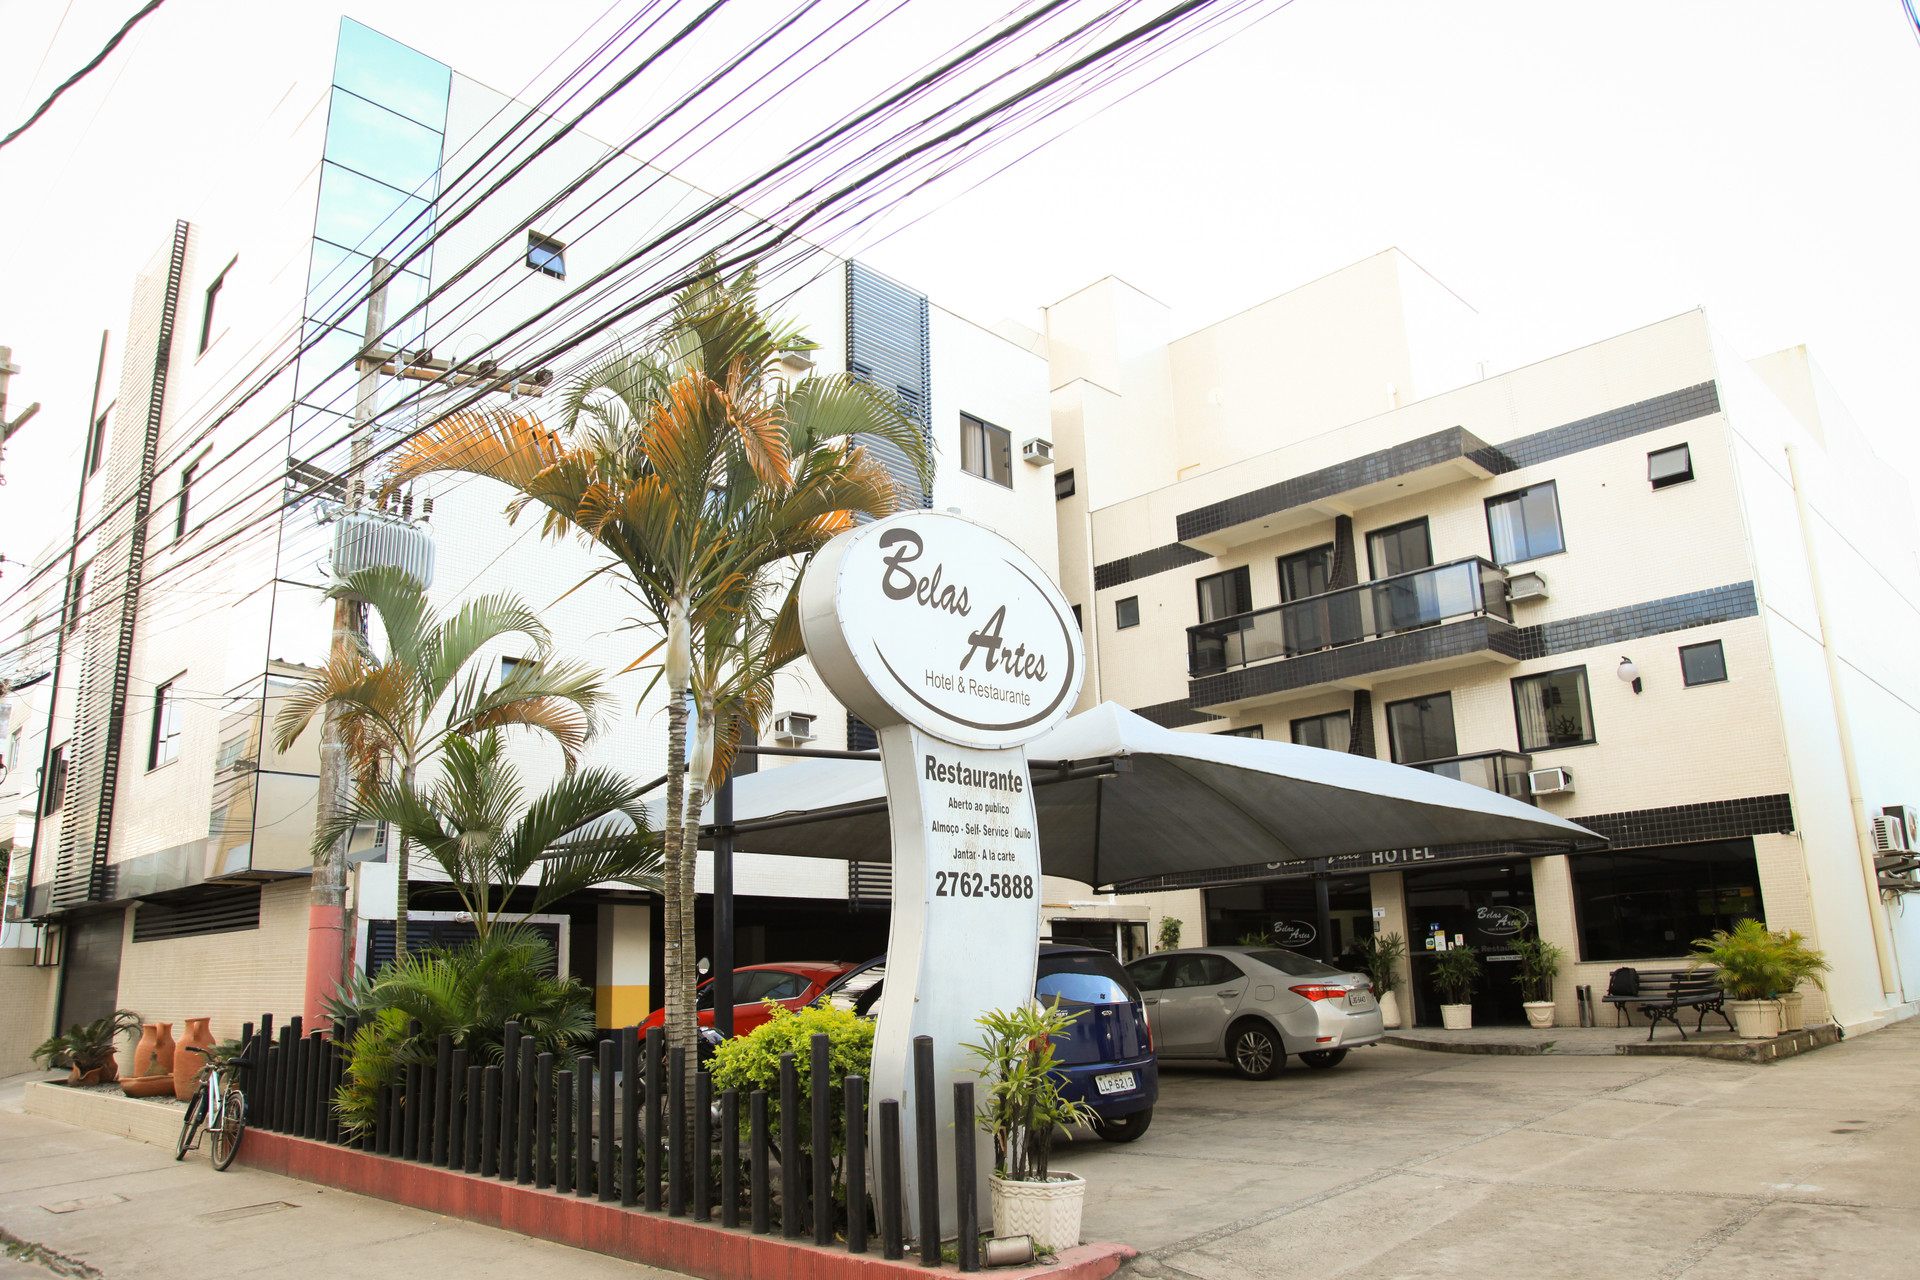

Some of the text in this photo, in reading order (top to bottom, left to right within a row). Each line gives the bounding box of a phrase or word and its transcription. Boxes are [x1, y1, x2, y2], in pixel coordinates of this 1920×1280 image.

[879, 528, 1047, 682] Belas Artes
[925, 669, 1031, 706] Hotel & Restaurante
[925, 754, 1023, 793] Restaurante
[948, 797, 1010, 814] Aberto ao publico
[932, 820, 959, 836] Almoço
[983, 824, 1009, 837] Service
[1014, 827, 1031, 839] Quilo
[953, 848, 976, 860] Jantar
[982, 849, 987, 860] A
[989, 849, 995, 860] la
[997, 851, 1016, 862] carte
[935, 871, 1033, 899] 2762-5888
[1477, 907, 1501, 919] Belas
[1274, 922, 1310, 939] Belas Artes
